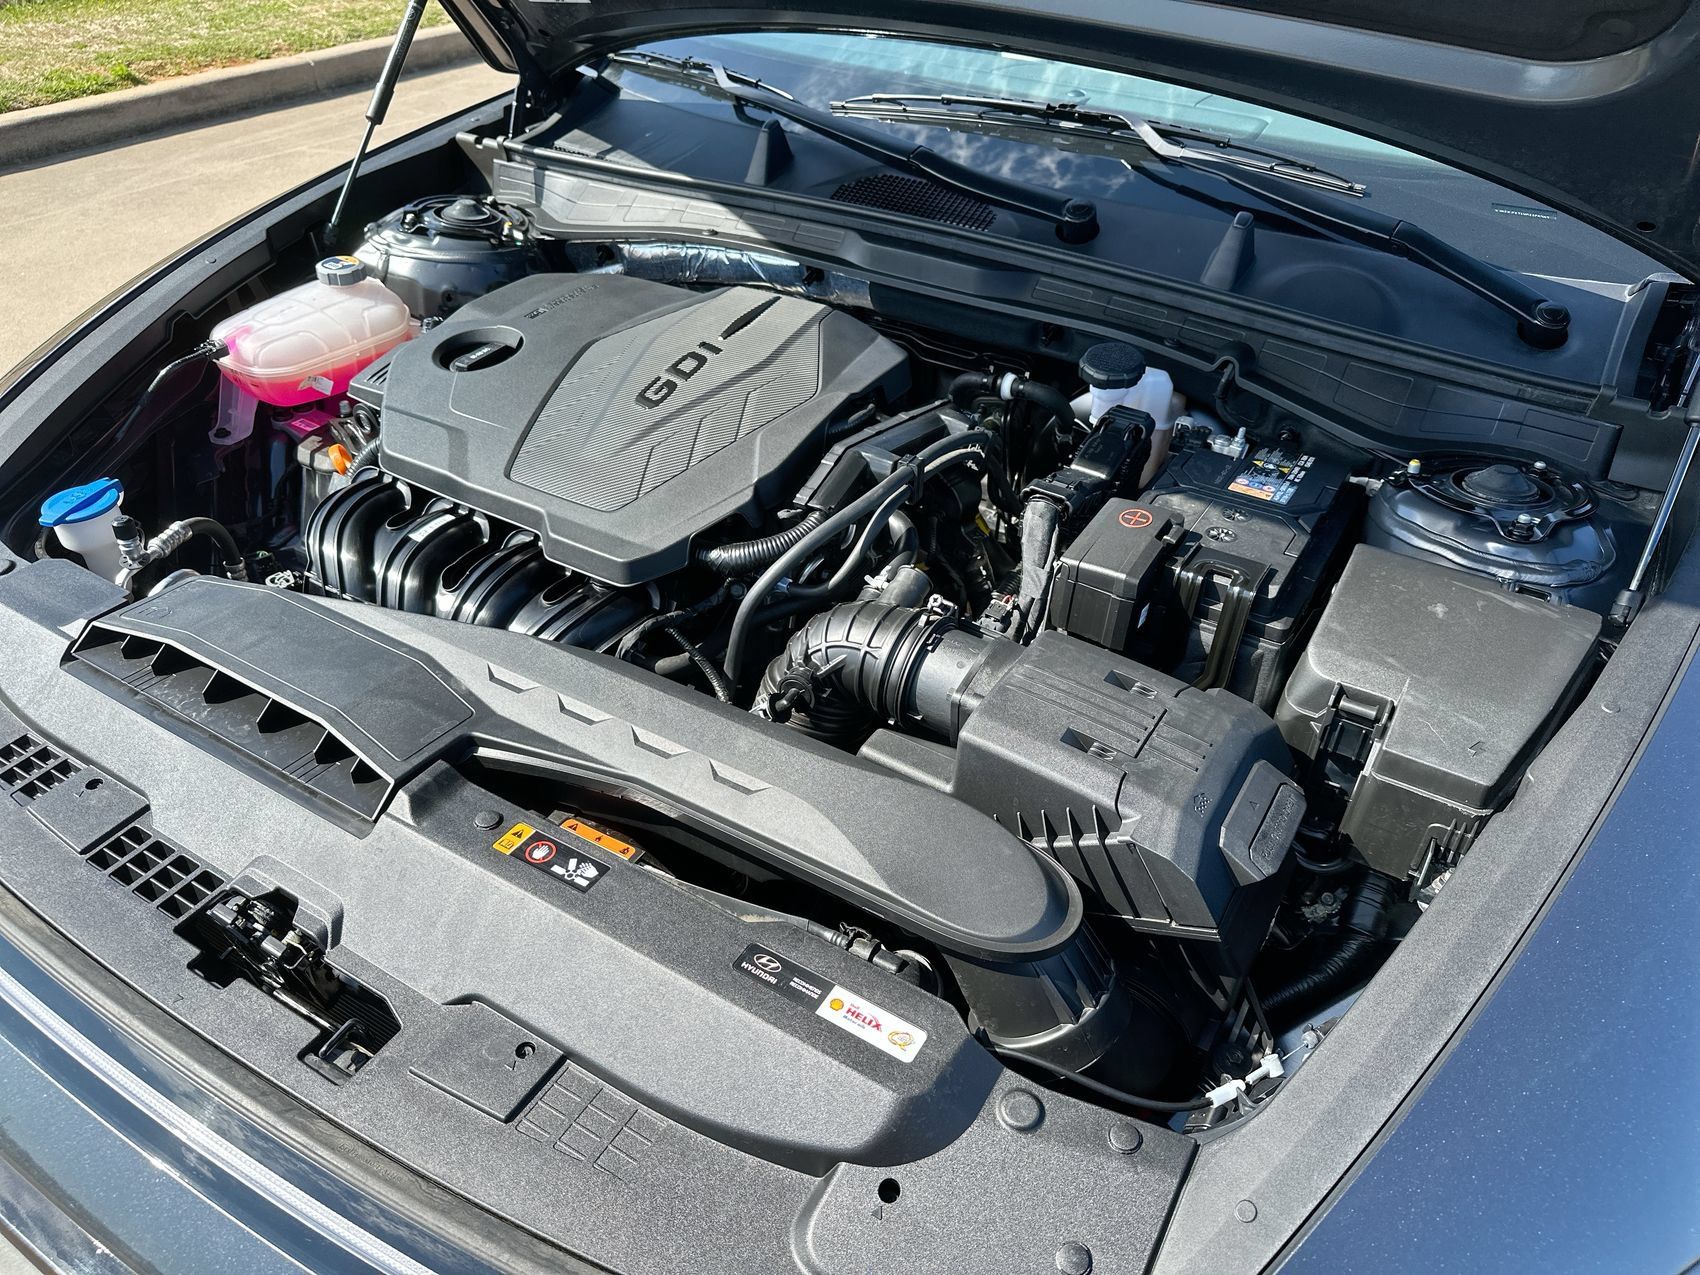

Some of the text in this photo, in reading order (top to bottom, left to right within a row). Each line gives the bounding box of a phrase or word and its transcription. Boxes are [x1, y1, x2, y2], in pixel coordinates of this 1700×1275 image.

[635, 341, 723, 409] GDI
[741, 961, 778, 985] HYUNDAI
[845, 1007, 882, 1032] HELIX
